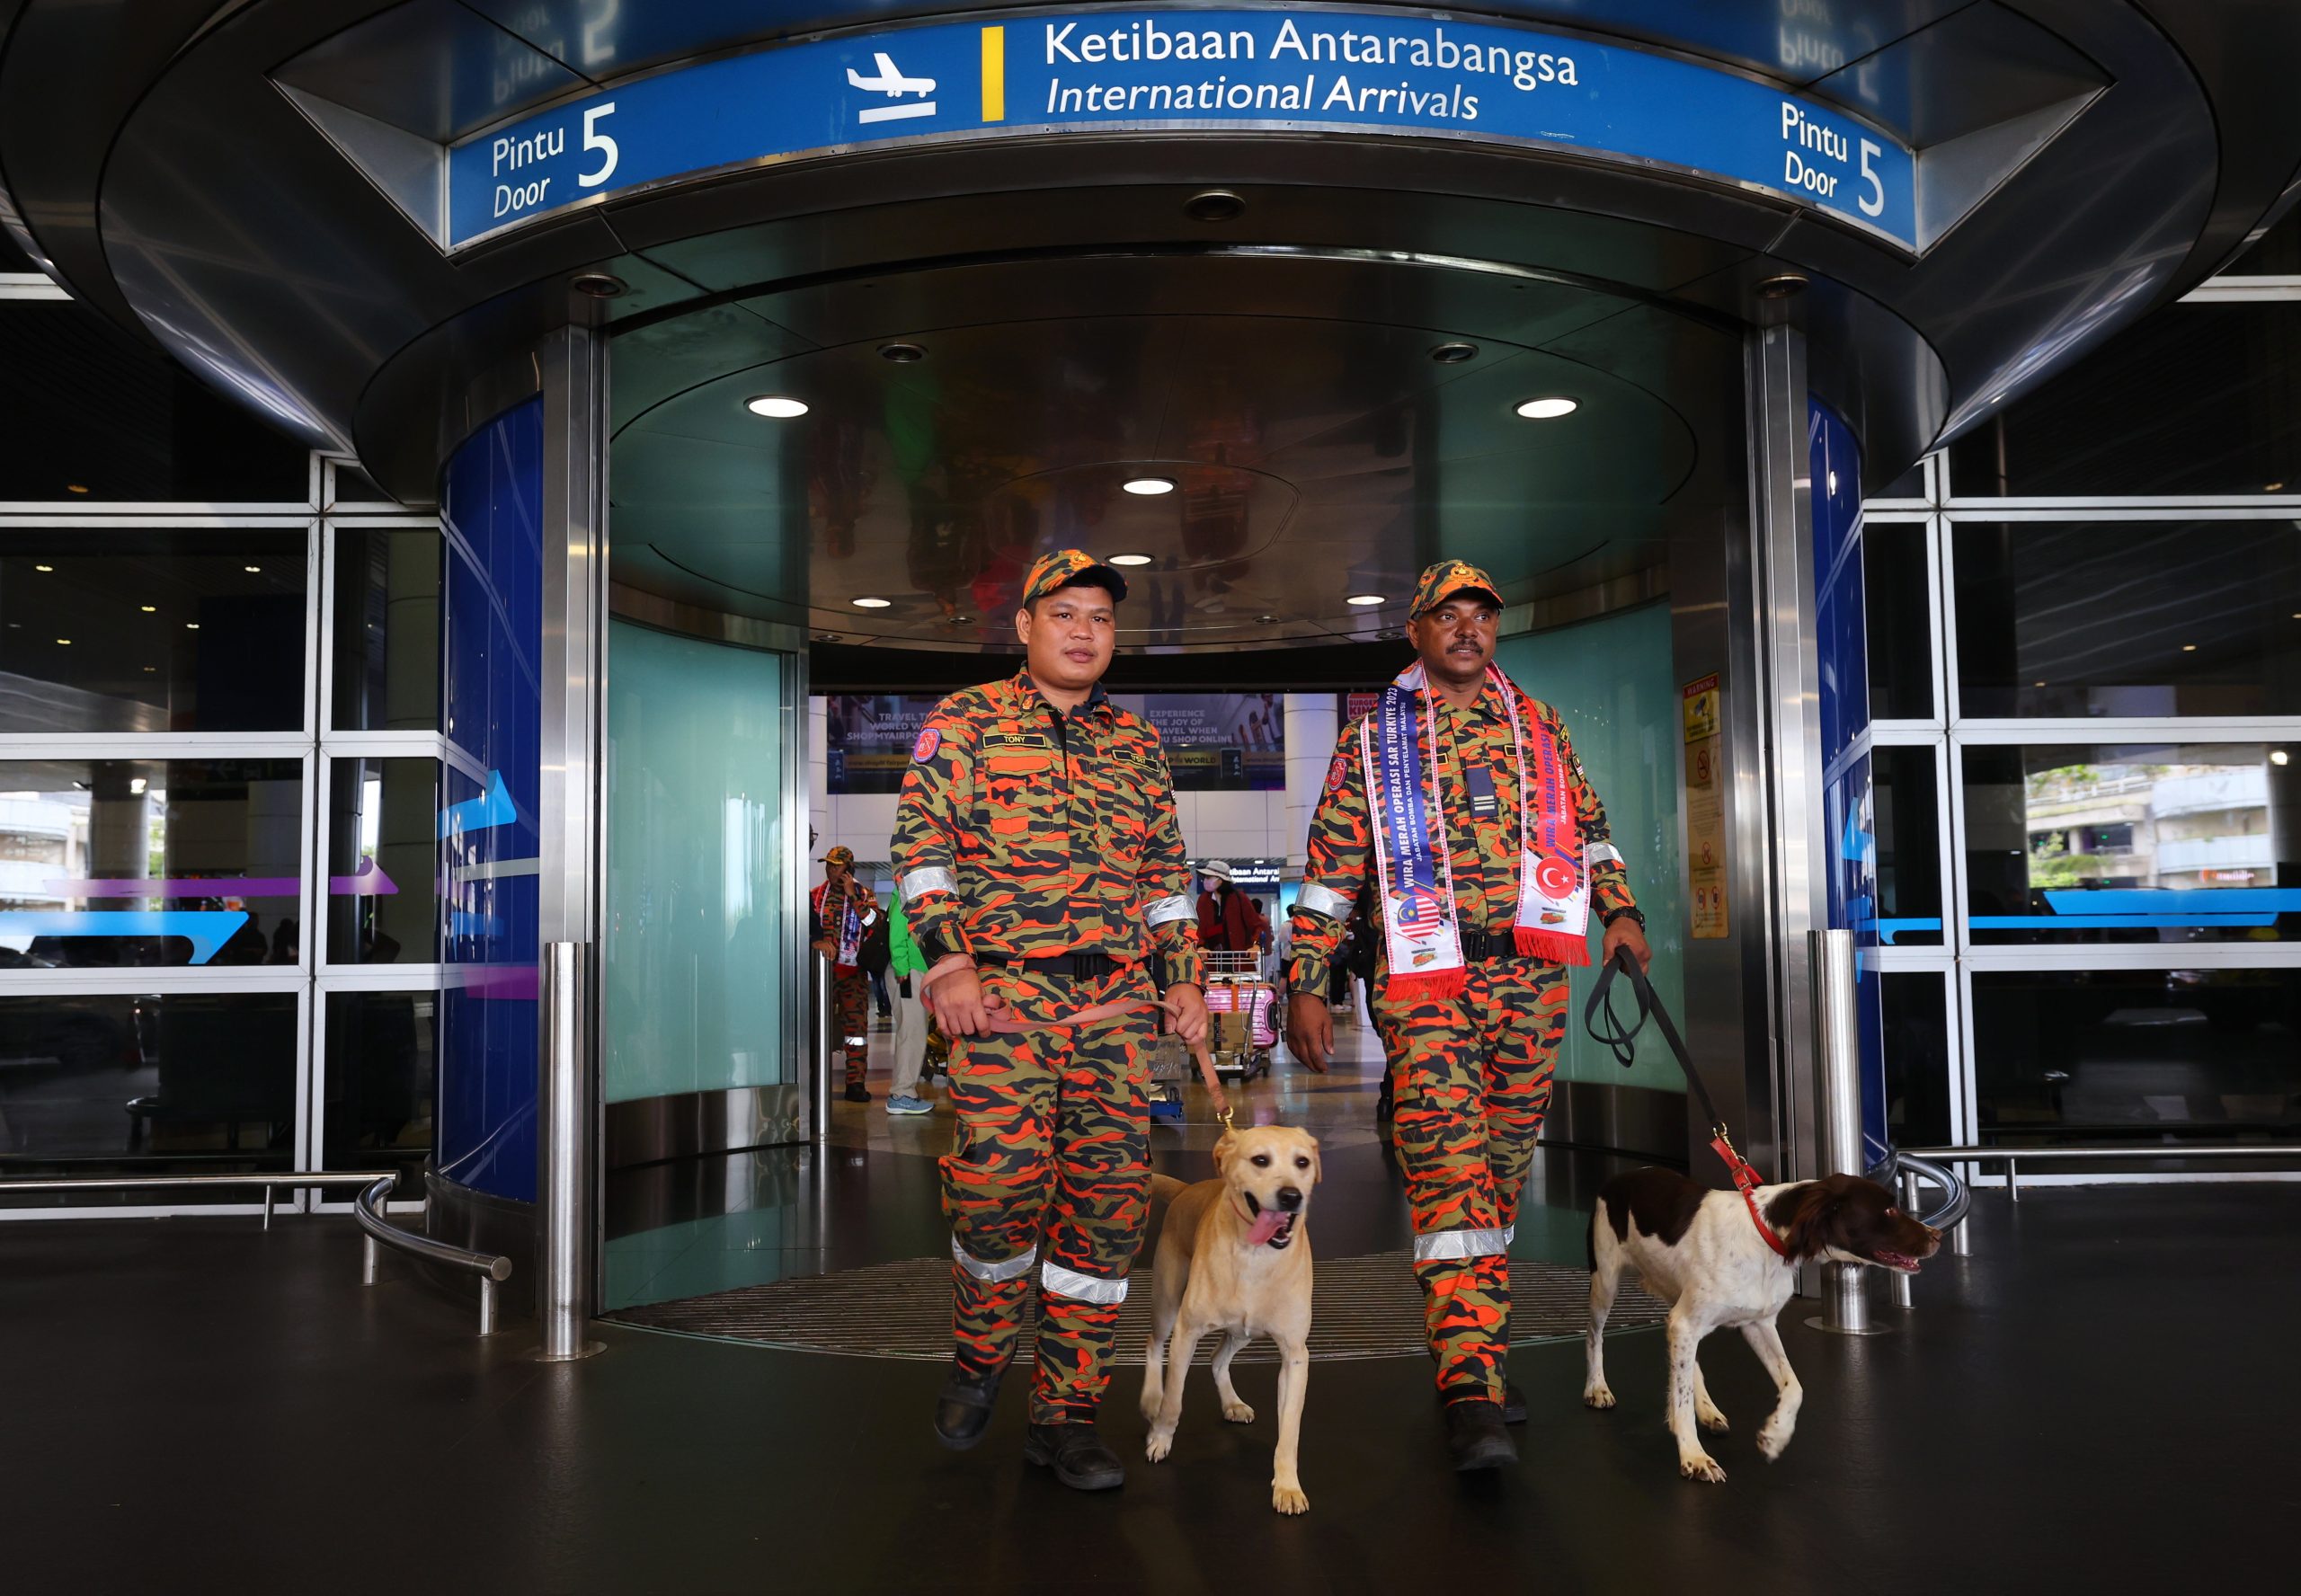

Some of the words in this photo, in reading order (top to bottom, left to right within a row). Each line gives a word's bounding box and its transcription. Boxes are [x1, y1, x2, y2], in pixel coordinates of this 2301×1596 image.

[1046, 19, 1255, 65] Ketibaan
[1269, 18, 1578, 92] Antarabangsa
[1046, 75, 1315, 113] International
[1321, 75, 1479, 120] Arrivals
[578, 101, 619, 188] 5
[1781, 101, 1848, 163] Pintu
[493, 127, 564, 177] Pintu
[1784, 150, 1838, 198] Door
[1858, 137, 1885, 217] 5
[493, 177, 551, 218] Door
[1386, 687, 1398, 705] 2023
[1687, 678, 1715, 696] WARNING
[870, 723, 910, 731] WORLD
[878, 713, 915, 721] TRAVEL
[1150, 718, 1168, 726] THE
[1171, 718, 1189, 726] JOY
[1190, 718, 1204, 726] OF
[1349, 706, 1372, 715] KIN
[1385, 707, 1398, 744] TURKIYE
[847, 732, 920, 740] SHOPMYAIRPO
[1004, 735, 1025, 744] TONY
[1388, 747, 1399, 766] SAR
[1401, 733, 1410, 778] PENYELAMAT
[1541, 733, 1554, 776] OPERASI
[1390, 768, 1404, 813] OPERASI
[1558, 763, 1566, 788] BOMBA
[1408, 797, 1416, 825] BOMBA
[1546, 777, 1556, 816] MERAH
[1396, 817, 1412, 856] MERAH
[1411, 828, 1422, 862] JABATAN
[1546, 819, 1556, 847] WIRA
[1230, 867, 1251, 875] tibaan
[1403, 859, 1415, 889] WIRA
